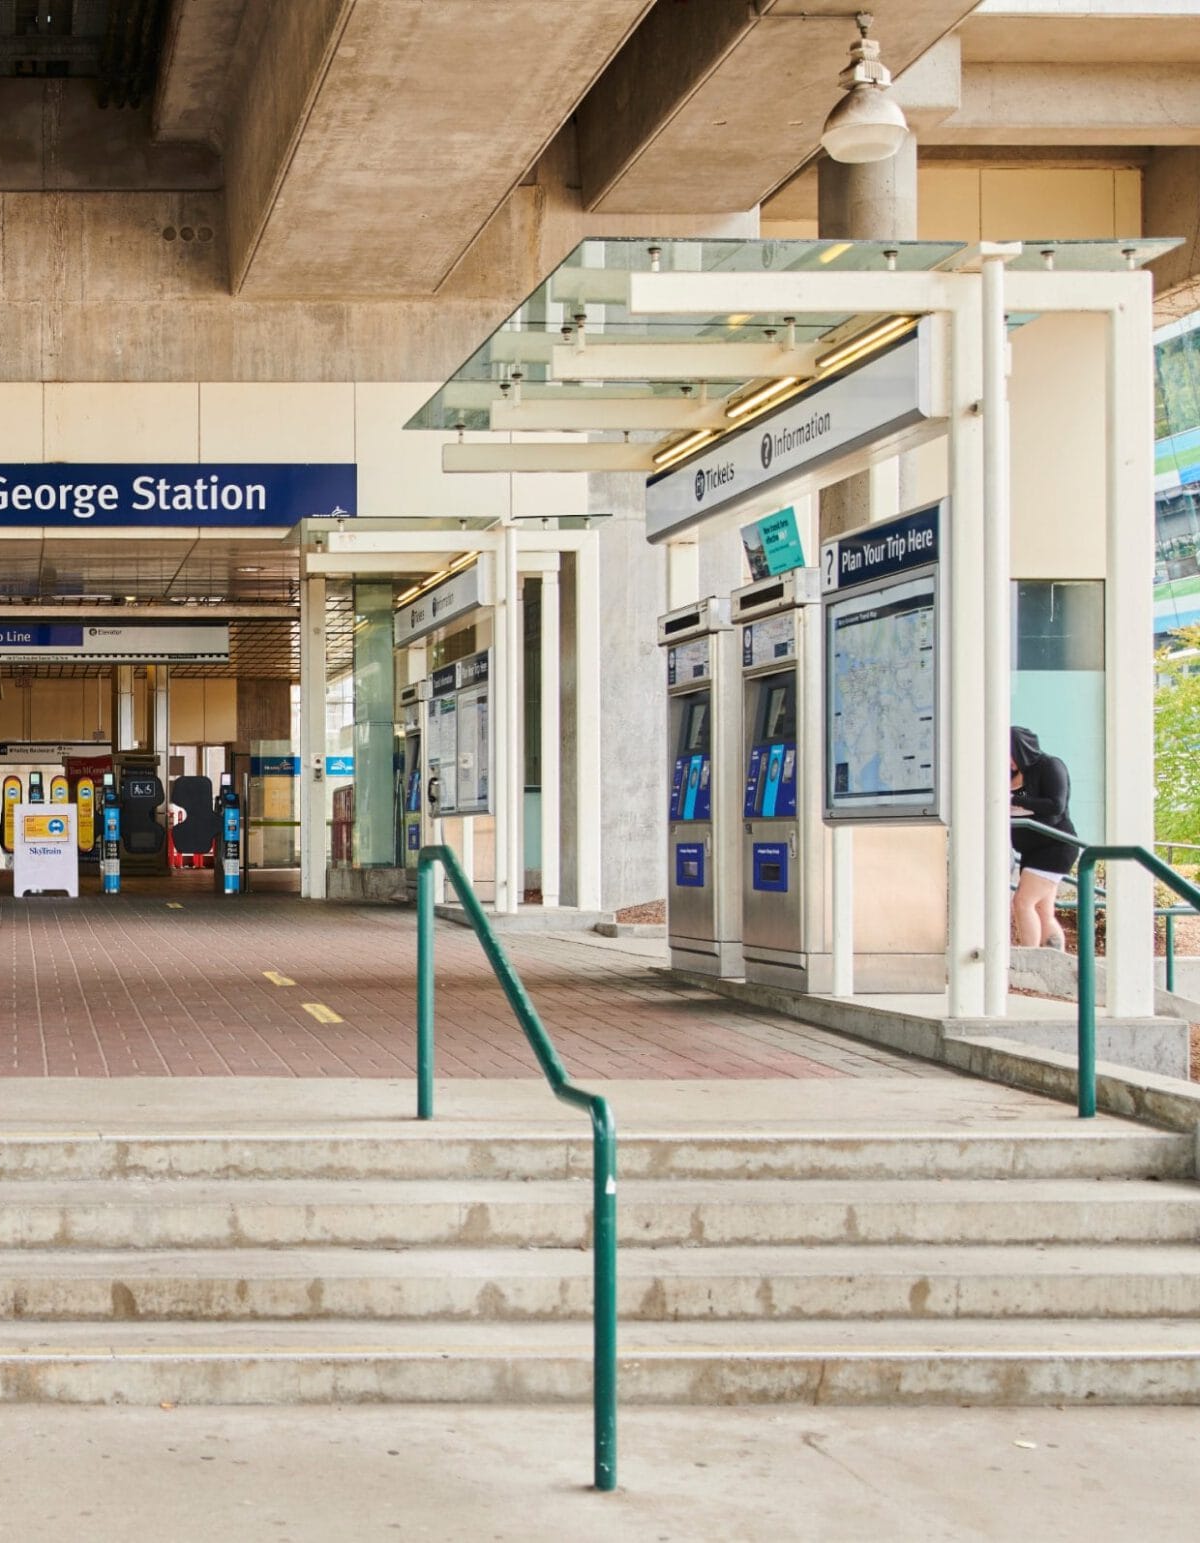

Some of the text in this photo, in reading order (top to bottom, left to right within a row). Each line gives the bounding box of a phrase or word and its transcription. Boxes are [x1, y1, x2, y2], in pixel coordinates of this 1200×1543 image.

[774, 411, 831, 457] Information
[705, 461, 735, 491] Tickets
[132, 475, 266, 510] Station
[841, 528, 933, 574] Plan Your Trip Here
[6, 630, 31, 642] Line
[29, 847, 62, 855] SkyTrain
